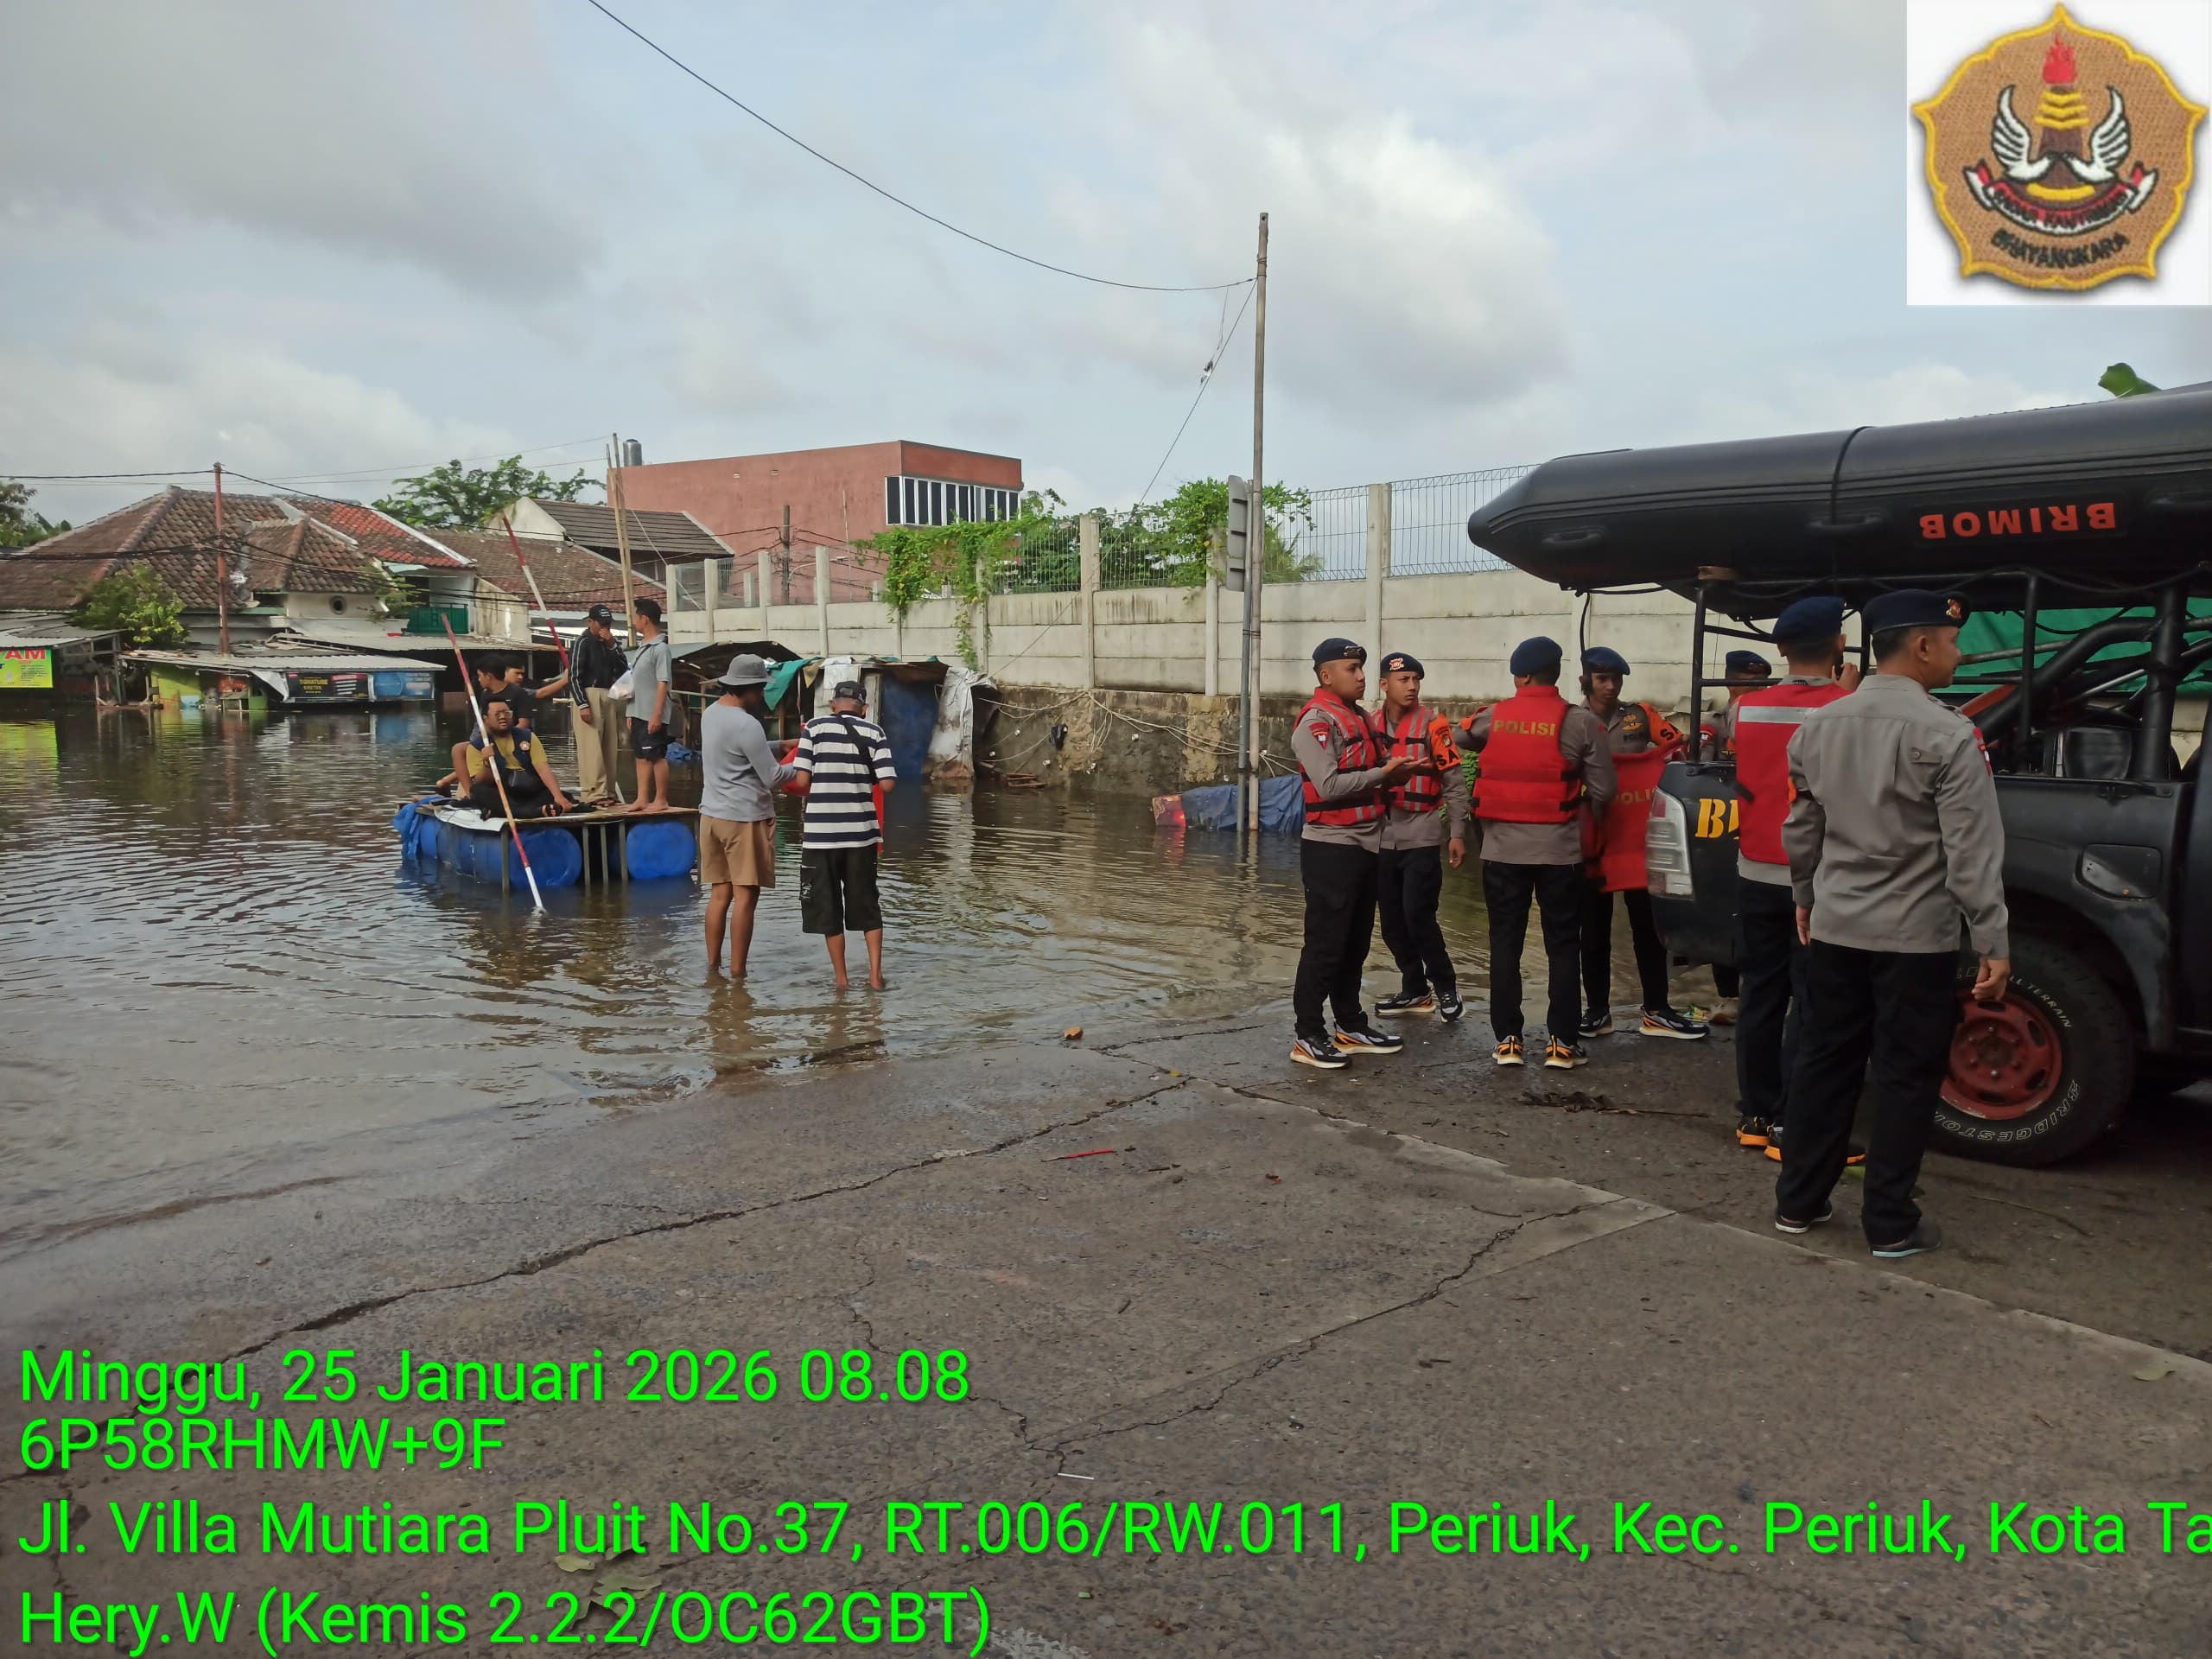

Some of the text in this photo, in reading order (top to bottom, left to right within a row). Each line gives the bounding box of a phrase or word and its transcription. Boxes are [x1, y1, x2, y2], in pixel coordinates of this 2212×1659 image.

[1919, 502, 2116, 539] BRIMOB
[0, 649, 47, 660] AM
[1492, 719, 1556, 737] POLISI
[1436, 748, 1460, 766] SA
[1616, 787, 1655, 804] OLI
[2026, 982, 2073, 1029] TERRAIN
[1935, 1079, 2081, 1142] BRIDGESTO
